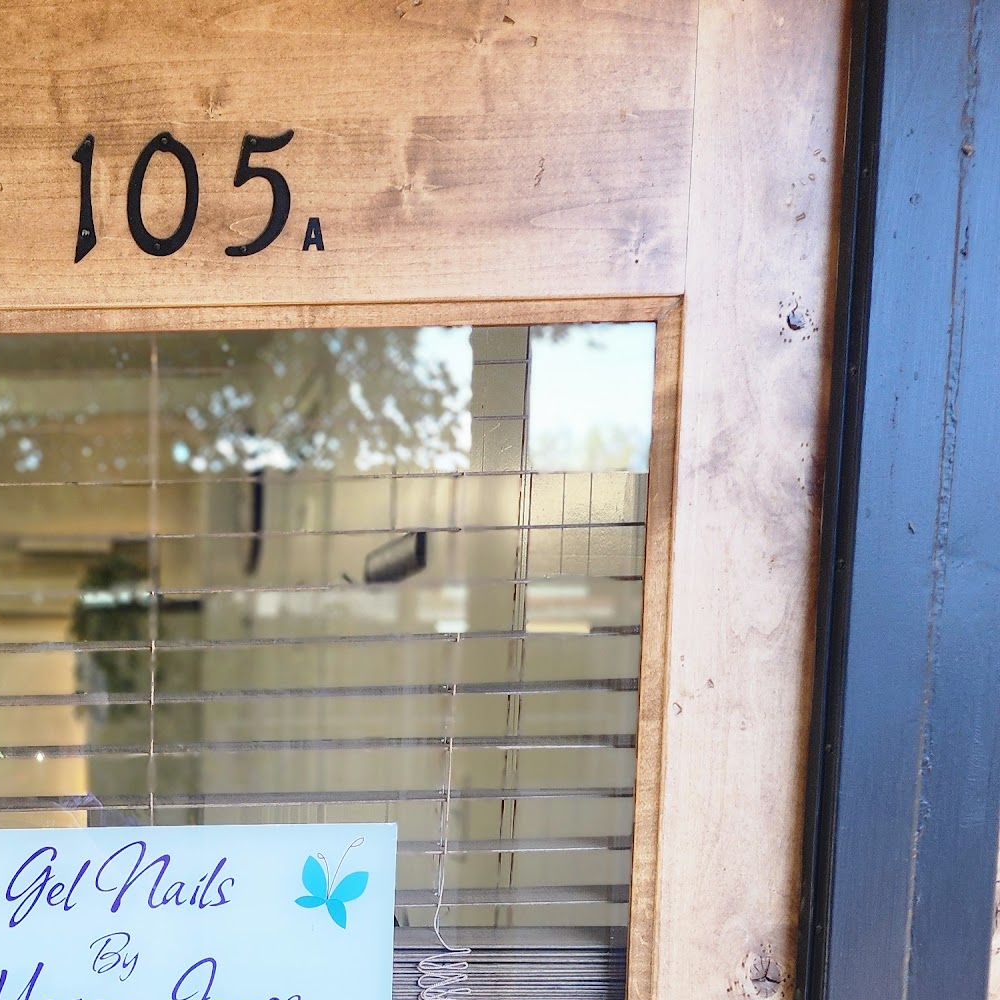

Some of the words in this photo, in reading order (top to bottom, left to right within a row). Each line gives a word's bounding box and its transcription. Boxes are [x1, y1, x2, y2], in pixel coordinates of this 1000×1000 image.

[5, 846, 91, 928] Gel
[95, 840, 235, 914] Nails
[89, 931, 139, 982] By
